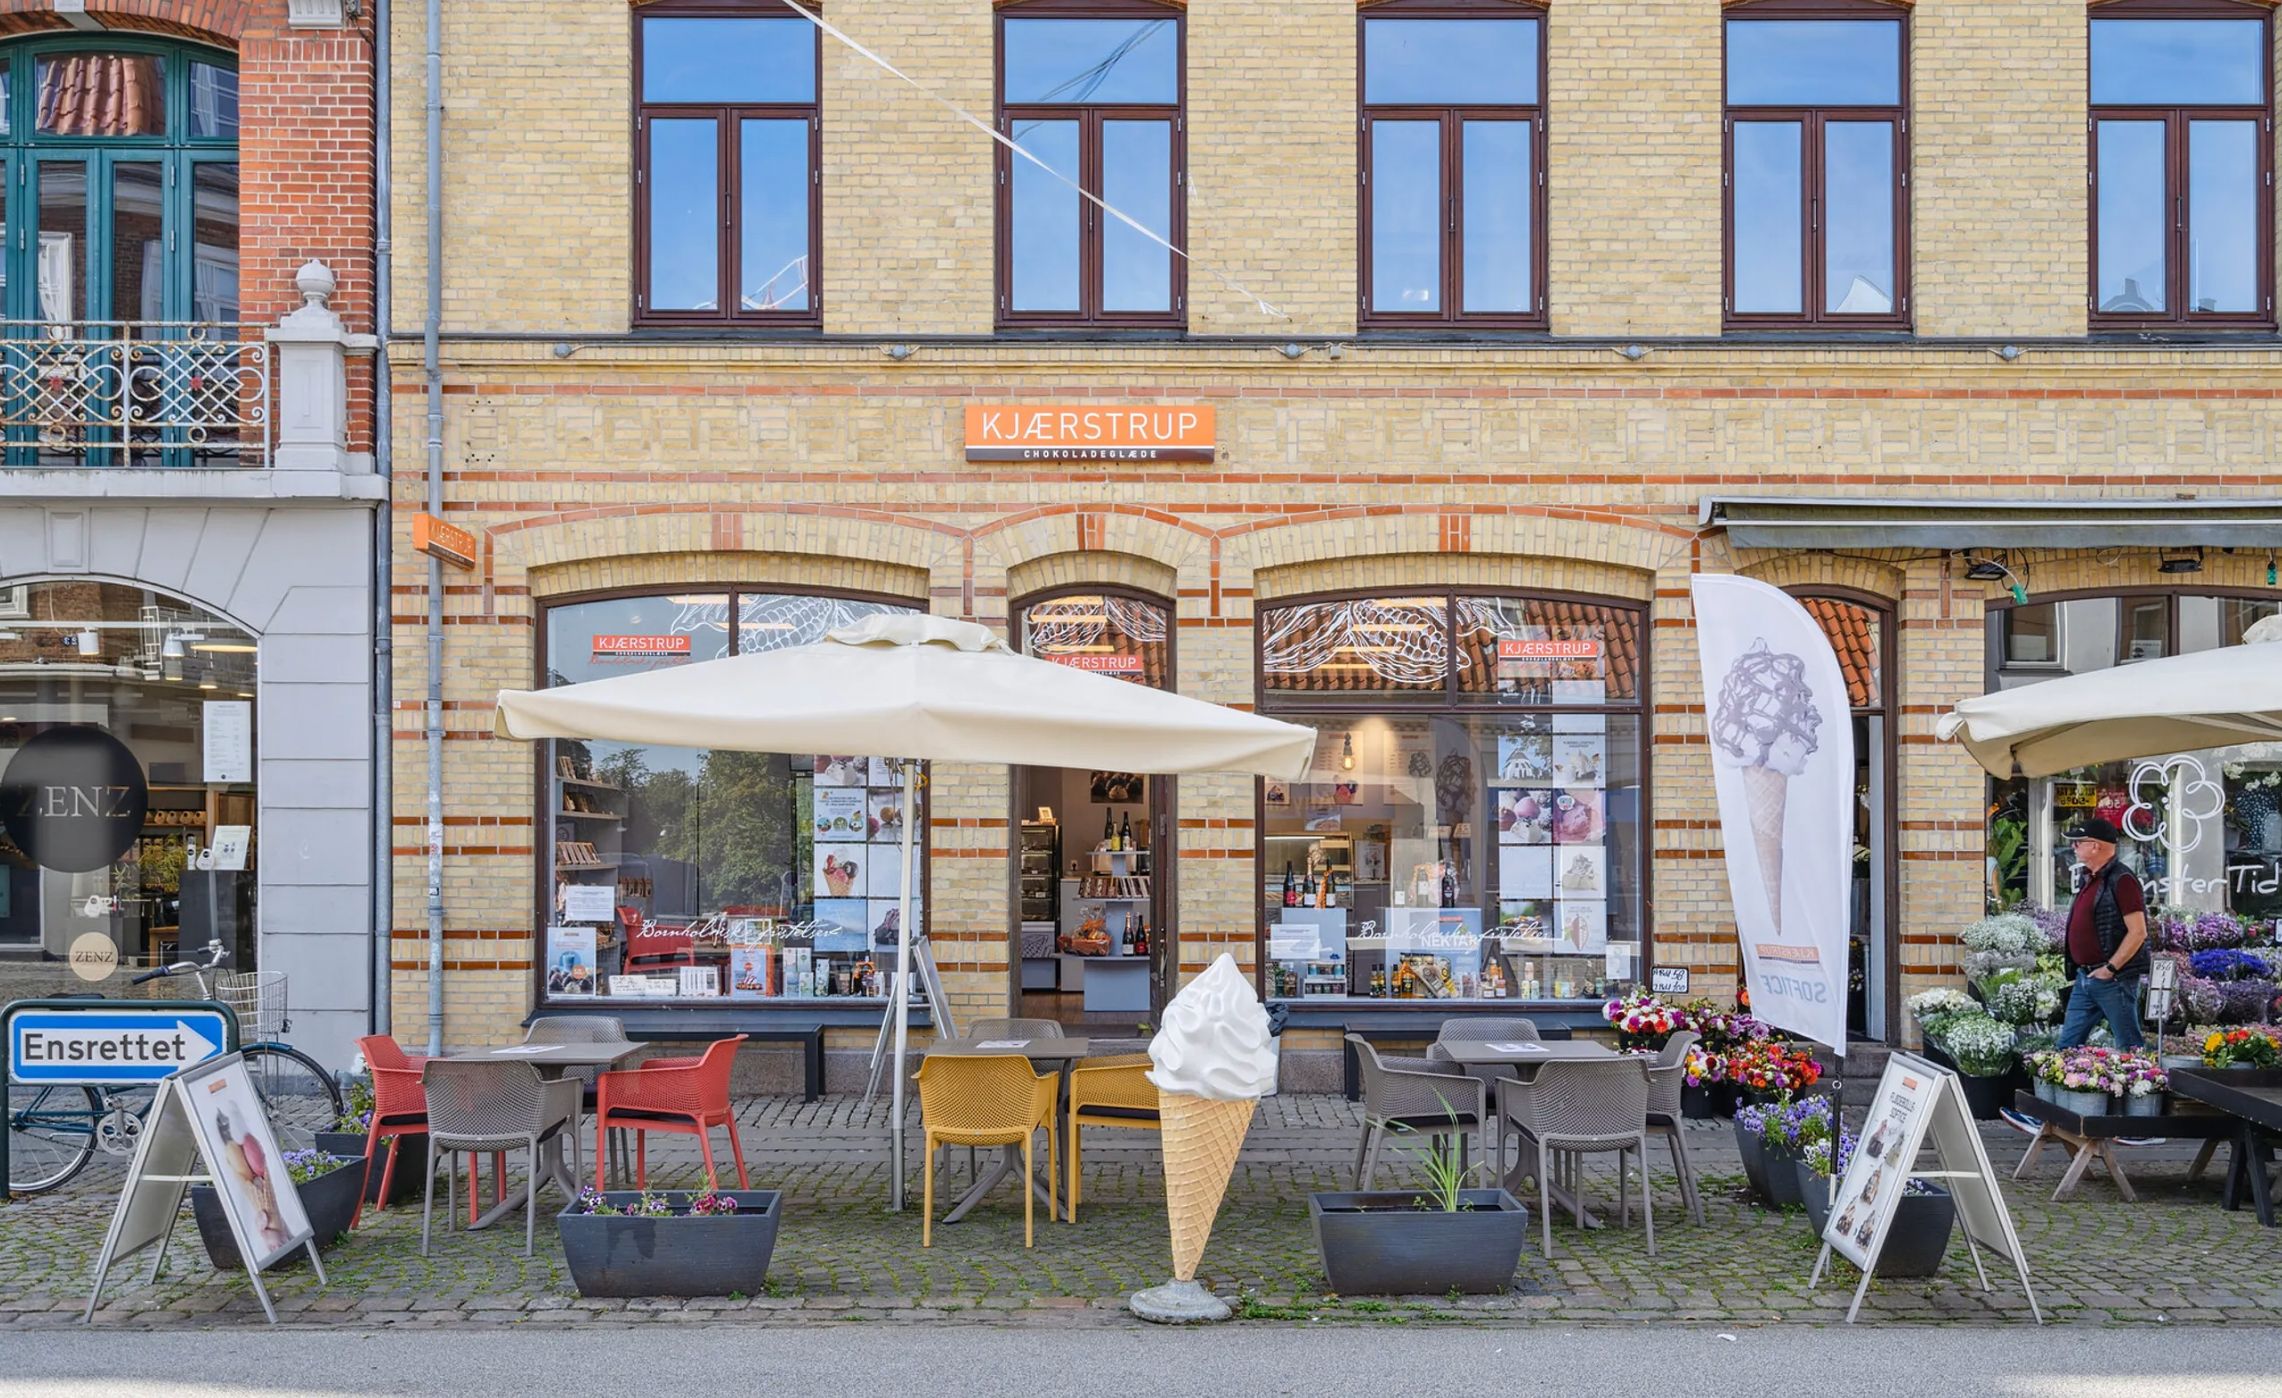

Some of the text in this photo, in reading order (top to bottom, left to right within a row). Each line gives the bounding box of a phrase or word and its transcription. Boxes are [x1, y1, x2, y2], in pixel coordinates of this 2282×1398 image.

[982, 411, 1198, 440] KJÆRSTRUP
[1023, 449, 1158, 459] CHOKOLADEGLÆDE
[599, 636, 685, 650] KJÆRSTRUP
[1505, 642, 1591, 655] KJÆRSTRUP
[1420, 935, 1479, 948] NEKTAR
[75, 951, 114, 963] ZENZ
[24, 1032, 187, 1061] Ensrettet
